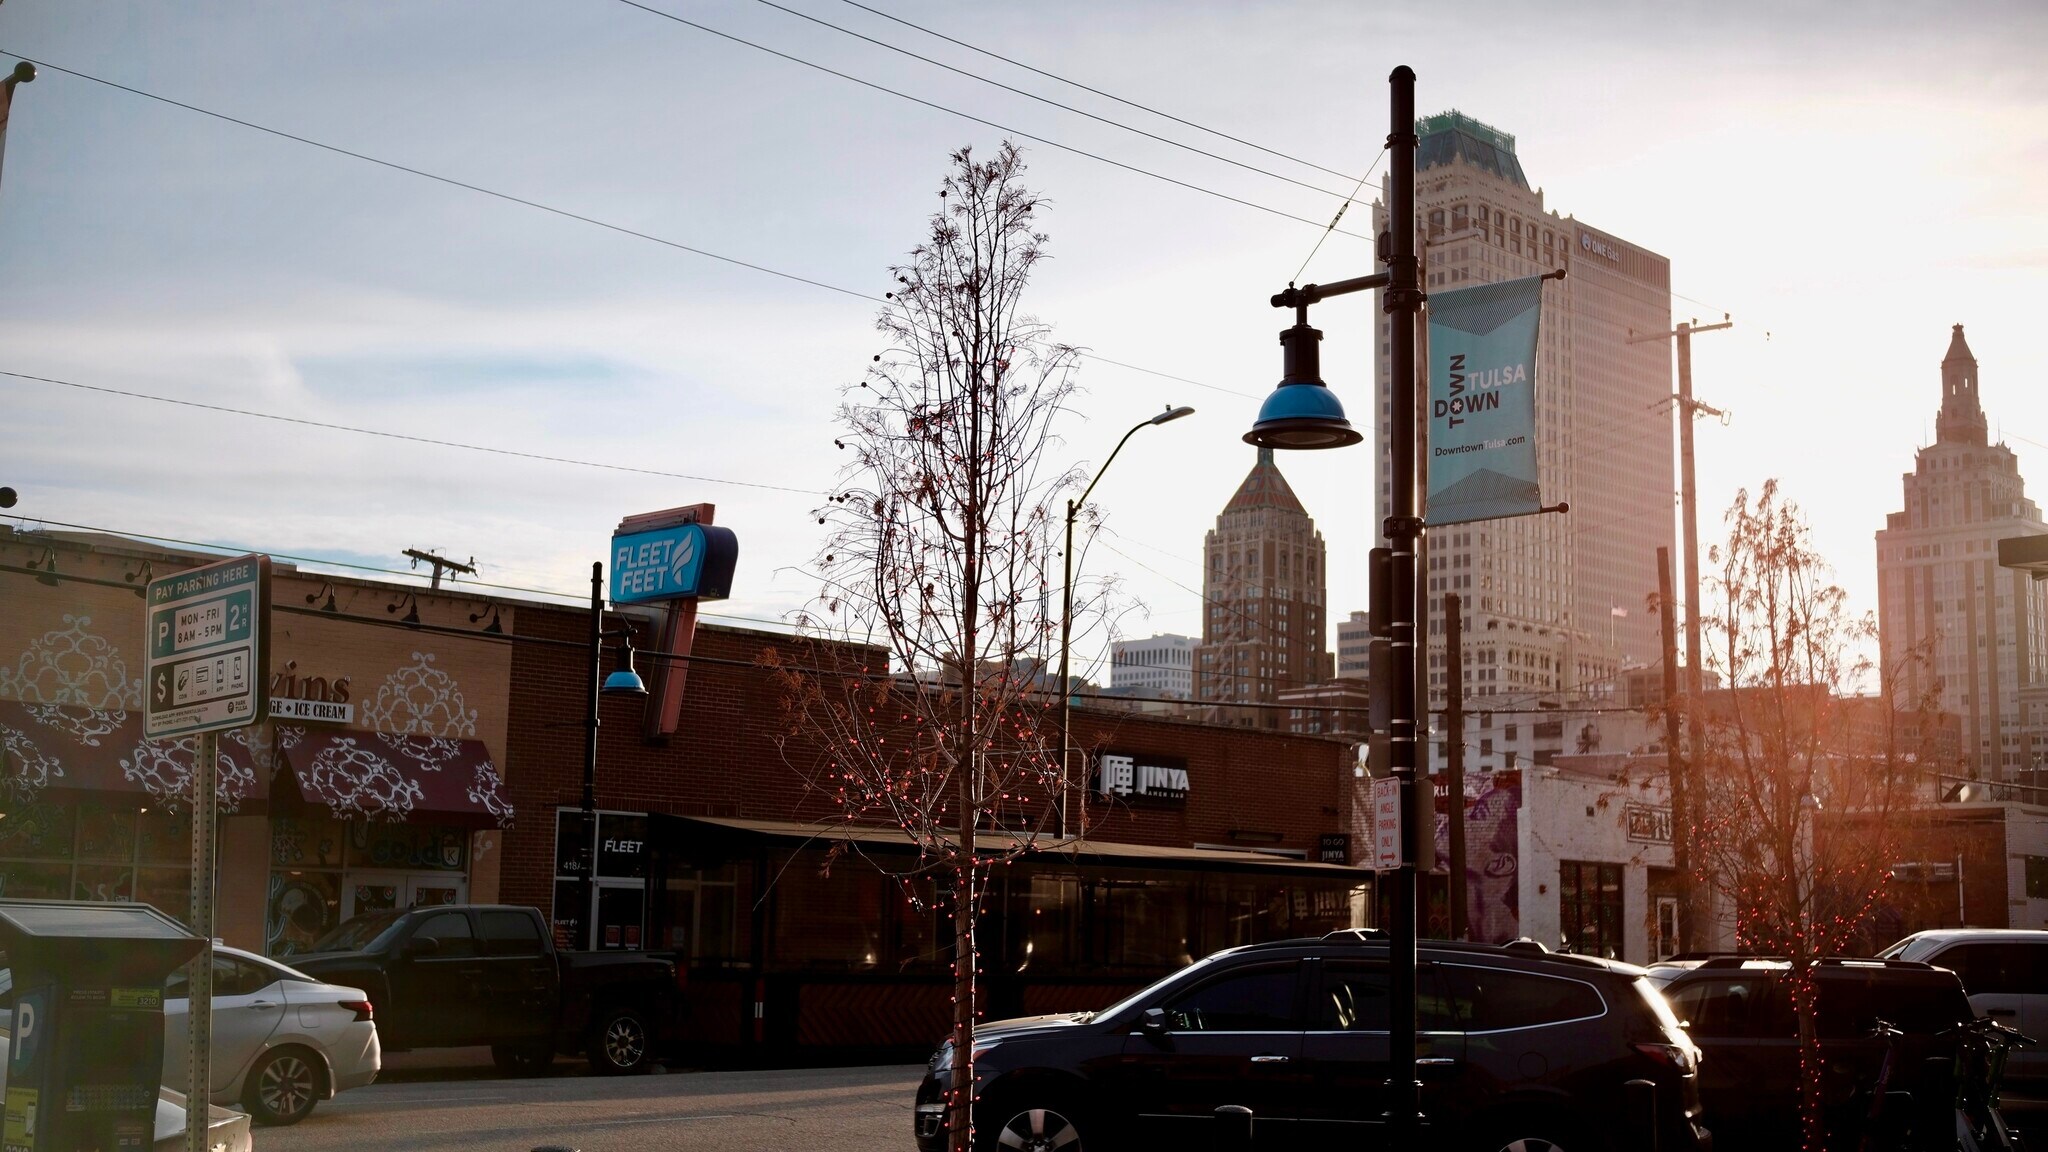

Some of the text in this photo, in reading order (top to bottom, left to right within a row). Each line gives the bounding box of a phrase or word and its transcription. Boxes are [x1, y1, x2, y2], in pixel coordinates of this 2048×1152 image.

[1468, 364, 1526, 391] TULSA
[1434, 390, 1499, 418] DOWN
[1435, 435, 1525, 456] DowntownTulsa.com
[616, 540, 675, 571] FLEET
[156, 565, 249, 600] PAY PARKING HERE
[621, 566, 668, 595] FEET
[181, 613, 199, 627] MON
[206, 608, 220, 621] FRI
[229, 604, 240, 631] 2
[159, 621, 169, 647] P
[270, 700, 347, 719] GE ICE CREAM
[1136, 766, 1190, 795] JINYA
[1380, 802, 1394, 814] ANGLE
[1378, 818, 1396, 831] PARKING
[604, 840, 643, 853] FLEET
[1381, 836, 1393, 847] ONLY
[1322, 850, 1344, 862] JINYA
[15, 1003, 35, 1060] P
